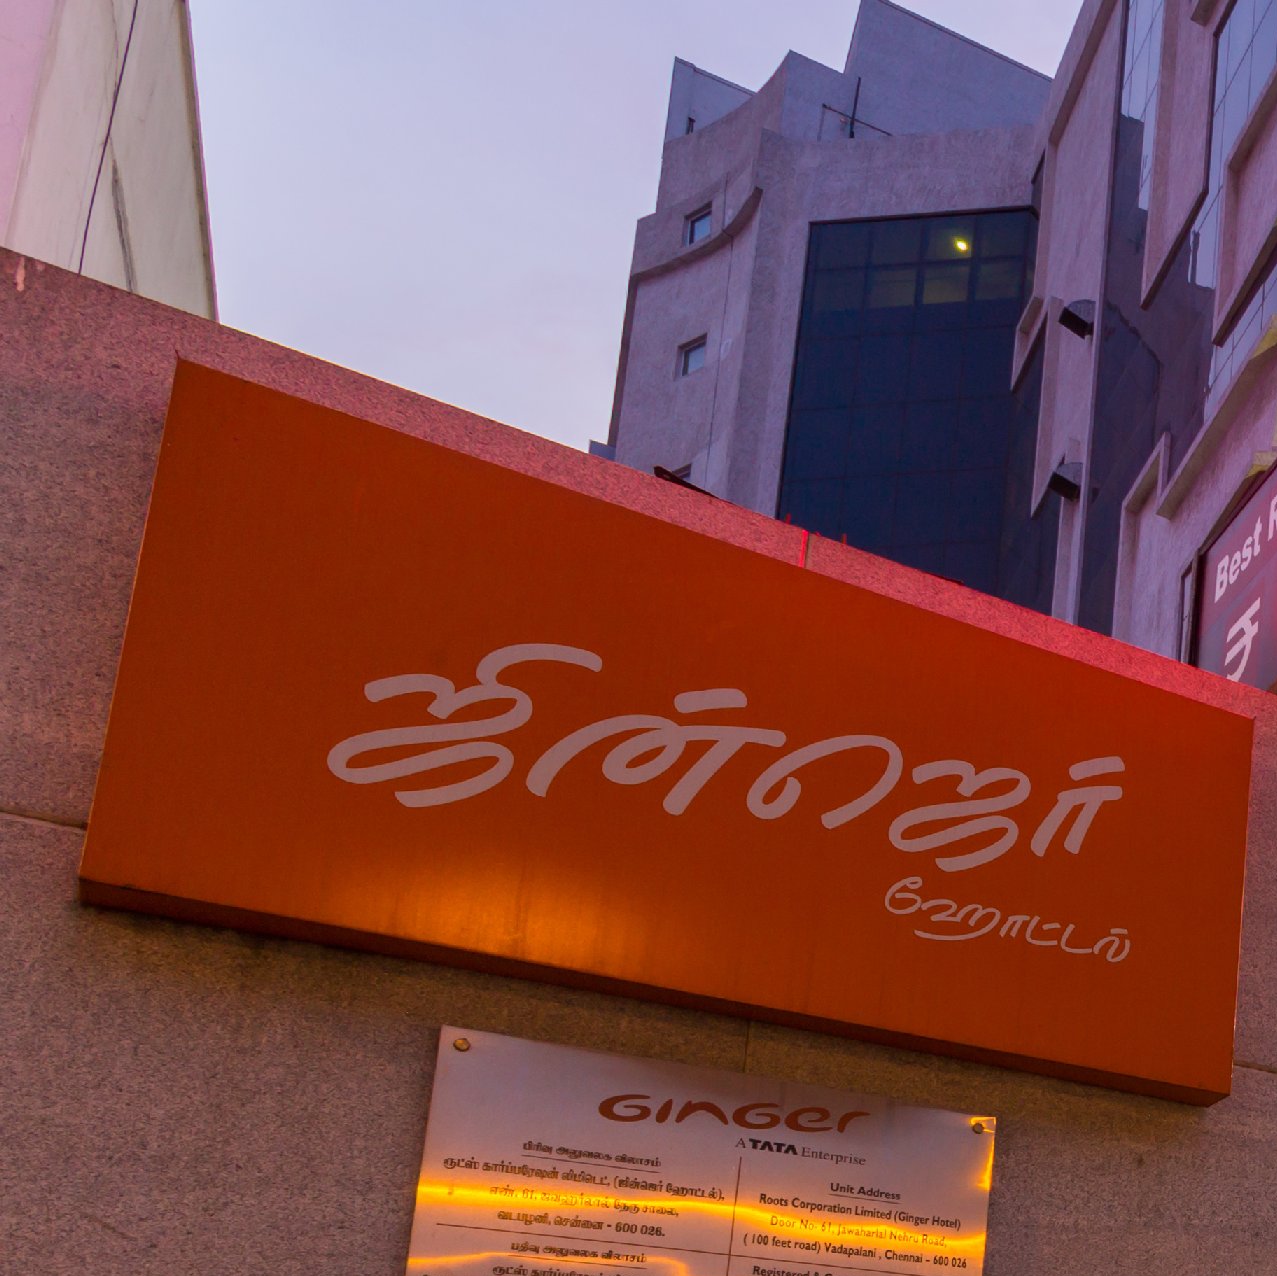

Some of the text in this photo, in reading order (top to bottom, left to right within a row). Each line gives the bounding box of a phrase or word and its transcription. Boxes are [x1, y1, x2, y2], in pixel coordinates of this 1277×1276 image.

[1214, 535, 1262, 603] Best
[736, 1137, 867, 1166] A TATA Enterprise
[830, 1182, 902, 1200] Unit Address
[759, 1193, 962, 1231] Roots Corporation Limited (Ginger Hotel)
[770, 1215, 797, 1228] Door
[837, 1224, 887, 1240] Jawaharlal
[888, 1230, 920, 1244] Nehru
[920, 1233, 948, 1249] Road,
[751, 1234, 968, 1269] 100 feet road) Vadapalani Chennai 600 026
